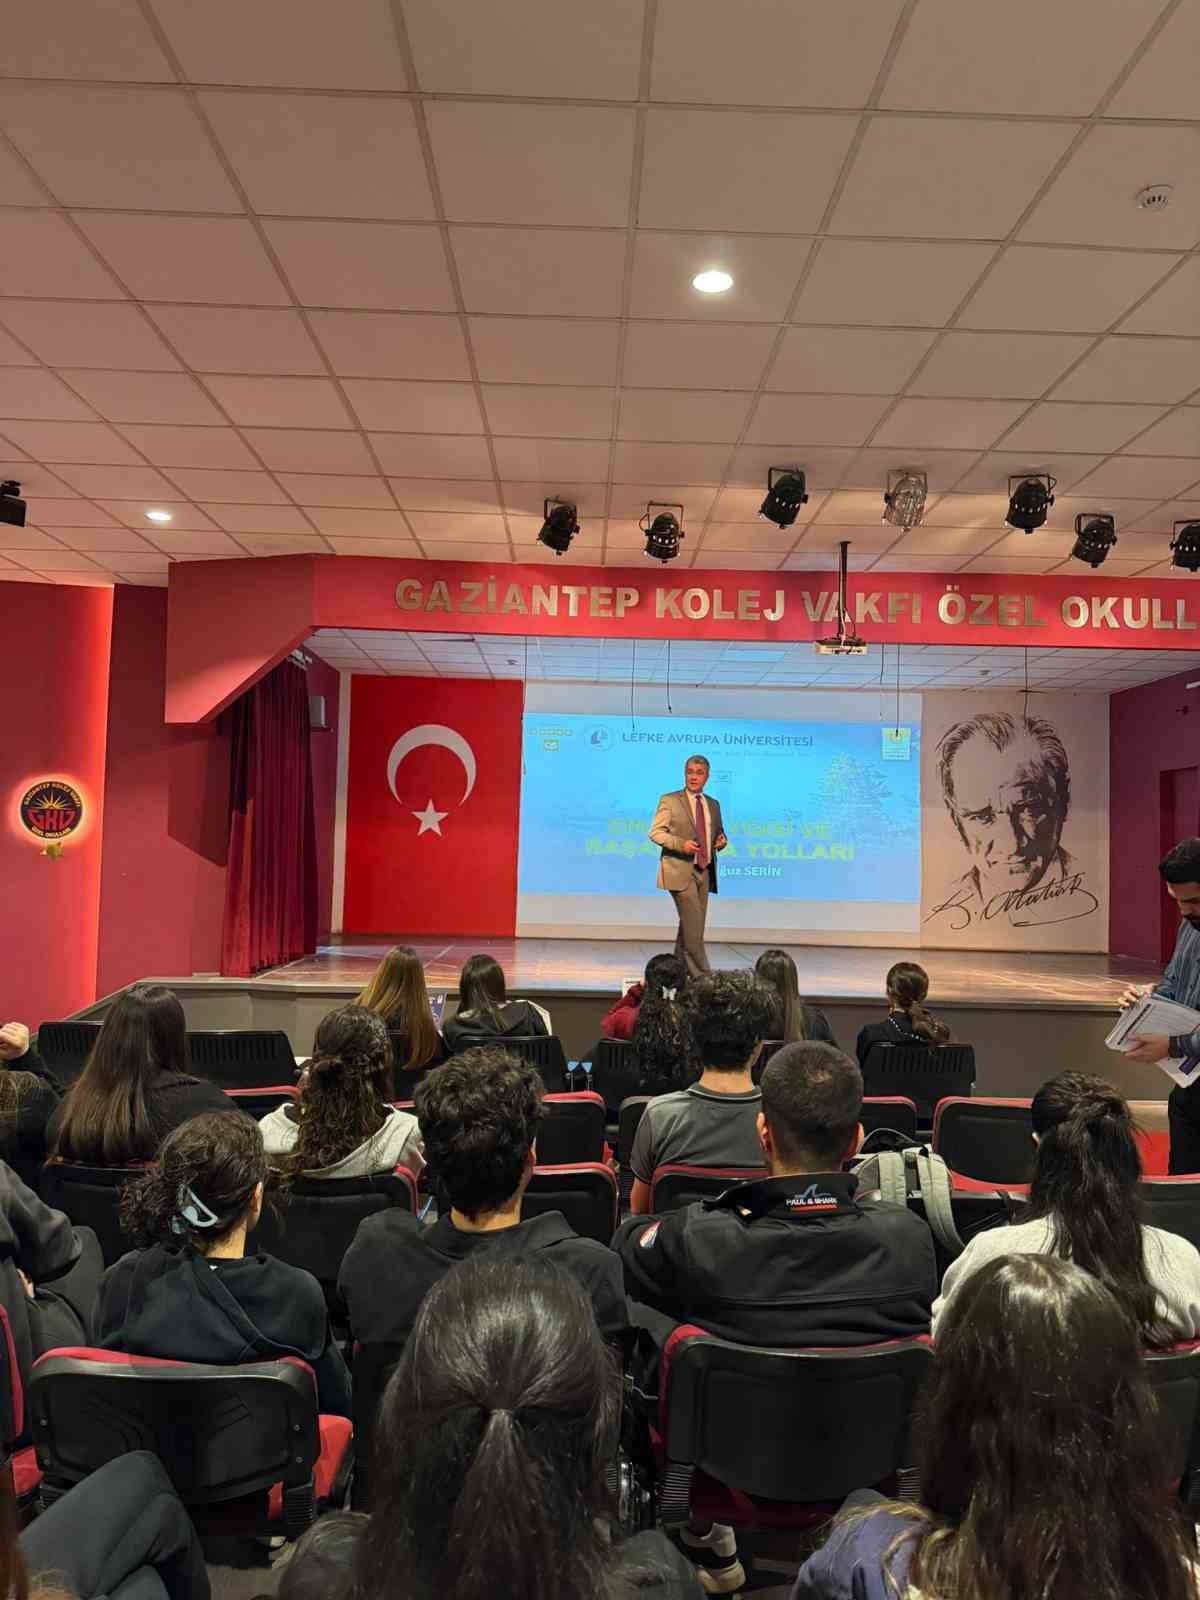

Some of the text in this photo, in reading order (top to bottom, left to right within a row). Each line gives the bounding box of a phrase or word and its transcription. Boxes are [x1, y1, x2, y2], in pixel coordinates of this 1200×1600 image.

[394, 576, 641, 618] GAZİANTEP
[655, 587, 786, 622] KOLEJ
[800, 591, 922, 624] VAKFI
[937, 584, 1046, 627] ÖZEL
[622, 732, 814, 747] LEFKE AVRUPA ÜNİVERSİTESİ
[744, 864, 782, 878] SERİN
